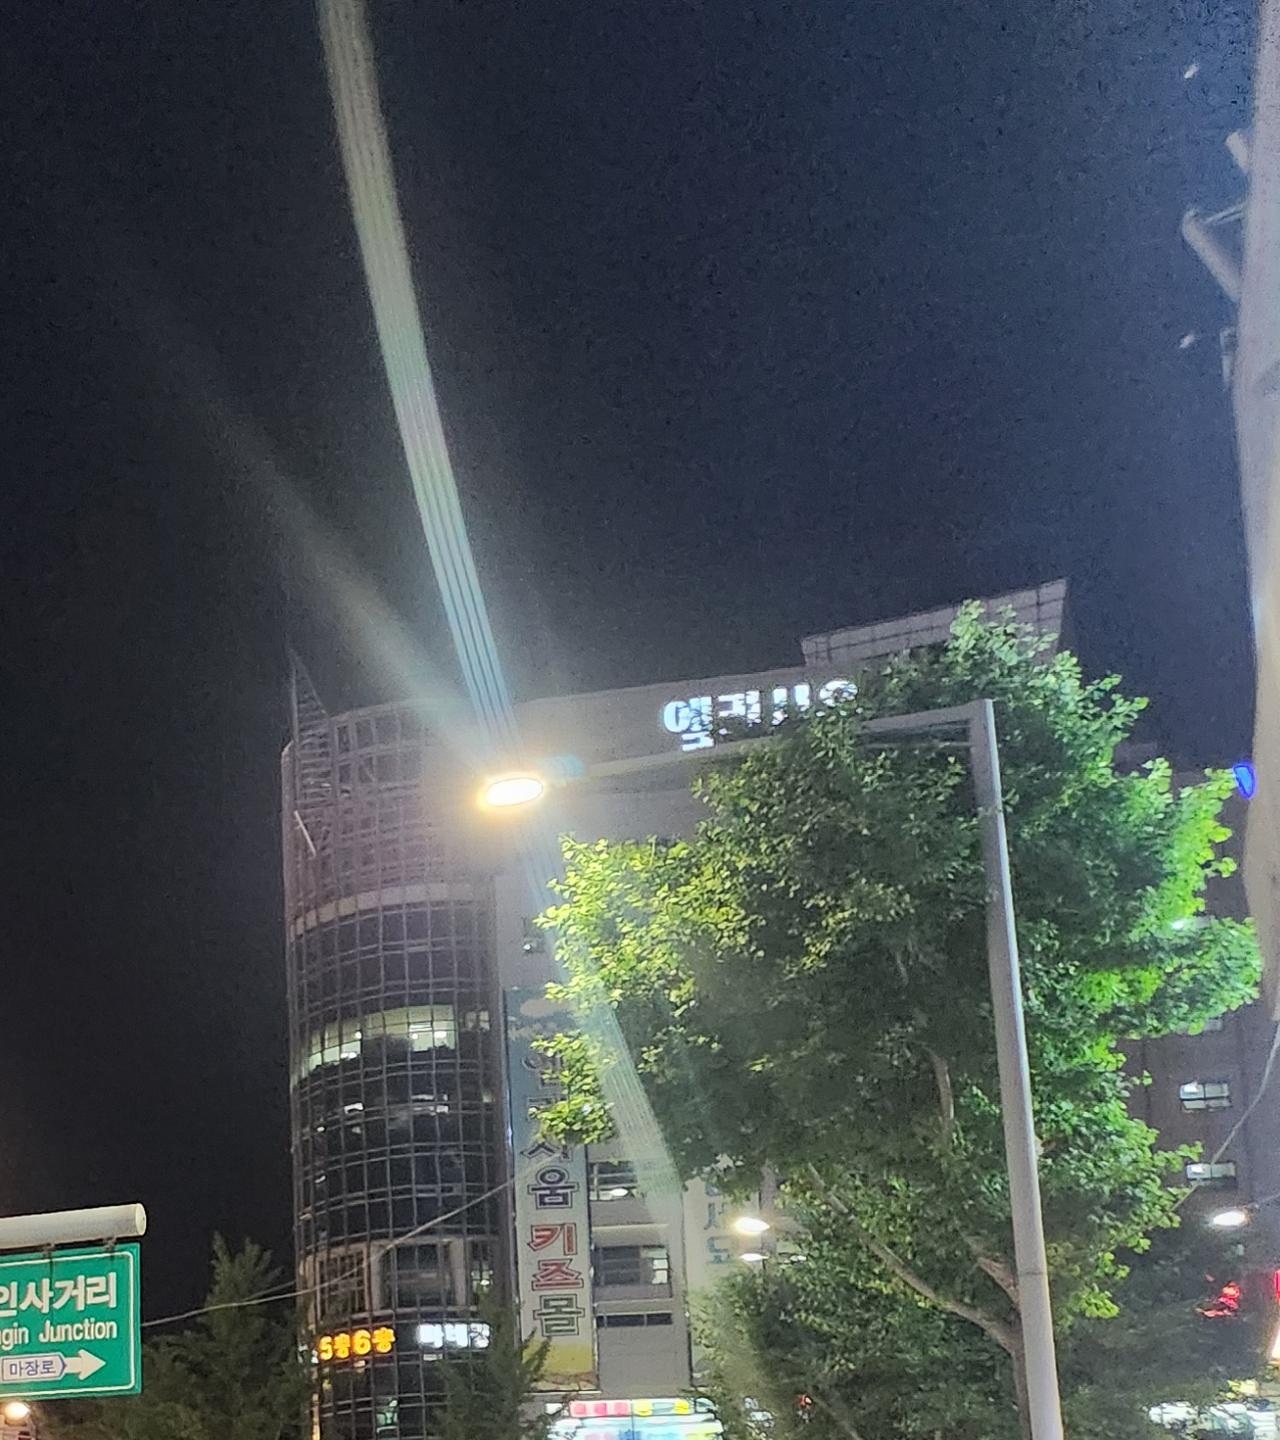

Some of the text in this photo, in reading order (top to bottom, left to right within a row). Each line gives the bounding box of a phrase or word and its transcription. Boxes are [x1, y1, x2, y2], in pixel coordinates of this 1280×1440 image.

[528, 1223, 585, 1337] 키즈몰
[39, 1317, 117, 1343] Junction
[9, 1359, 57, 1377] 마장로
